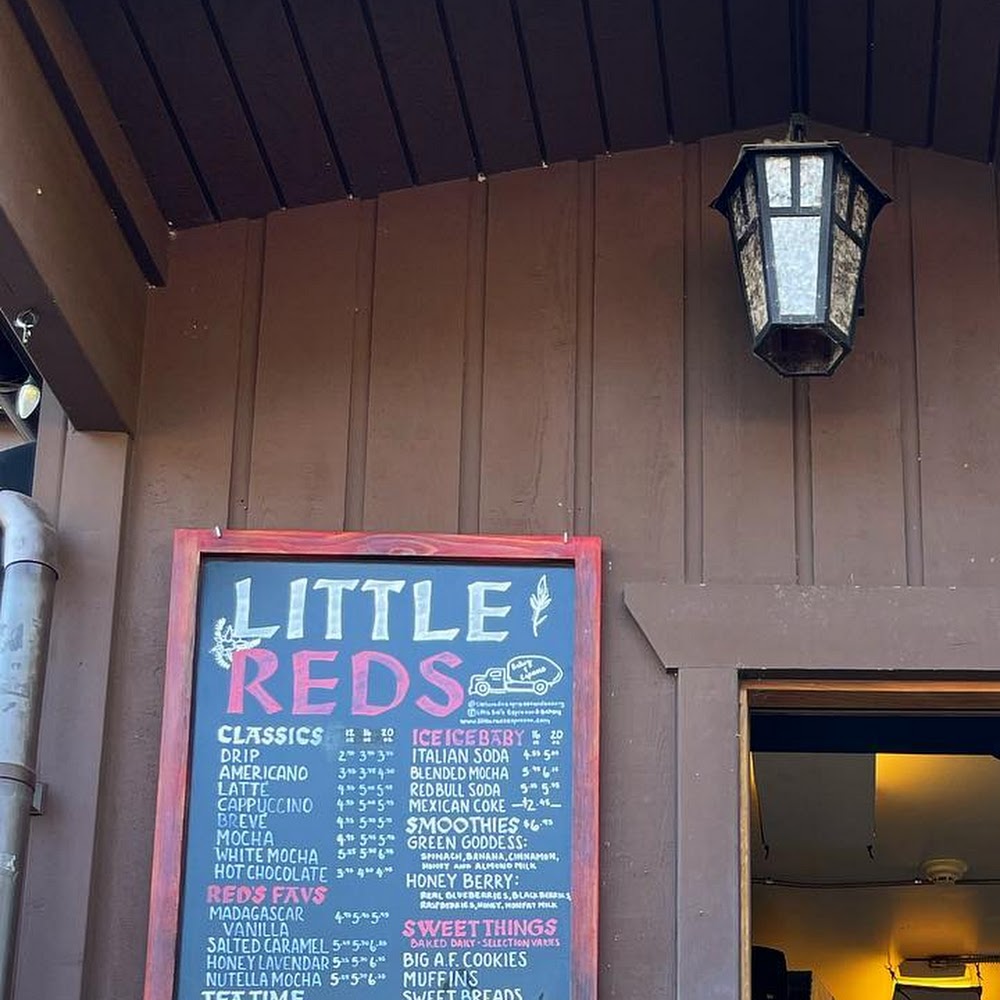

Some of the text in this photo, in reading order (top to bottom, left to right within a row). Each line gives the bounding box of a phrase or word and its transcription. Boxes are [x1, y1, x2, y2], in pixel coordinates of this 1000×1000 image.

[233, 578, 512, 642] LITTLE
[226, 648, 464, 717] REDS
[218, 725, 324, 745] CLASSICS
[413, 729, 442, 746] ICE
[446, 729, 477, 746] ICE
[479, 729, 525, 746] BABY
[550, 730, 563, 740] 20
[221, 749, 260, 763] DRIP
[412, 749, 469, 763] ITALIAN
[474, 749, 509, 763] SODA
[219, 765, 308, 781] AMERICANO
[410, 766, 466, 780] BLENDED
[469, 766, 509, 780] MOCHA
[468, 783, 500, 797] SODA
[218, 798, 313, 813] CAPPUCCINO
[409, 800, 469, 813] MEXICAN
[473, 799, 506, 813] COKE
[406, 817, 520, 834] SMOOTHIES
[216, 829, 274, 846] MOCHA
[407, 835, 527, 850] GREEN GODDESS:
[215, 847, 263, 862] WHITE
[267, 849, 318, 865] MOCHA
[215, 864, 244, 879] HOT
[247, 865, 328, 883] CHOCOLATE
[406, 874, 519, 889] HONEY BERRY:
[272, 886, 328, 904] FAVS
[209, 906, 304, 922] MADAGASCAR
[223, 922, 289, 937] VANILLA
[402, 918, 558, 937] SWEET THINGS
[207, 938, 260, 954] SALTED
[264, 938, 329, 954] CARAMEL
[410, 938, 560, 948] BAKED DAILY SELECTION VARIES
[207, 955, 256, 970] HONEY
[259, 956, 330, 971] LAVENDAR
[403, 951, 527, 968] BIG A.F. COOKIES
[206, 972, 268, 987] NUTELLA
[271, 972, 321, 987] MOCHA
[403, 970, 478, 988] MUFFINS
